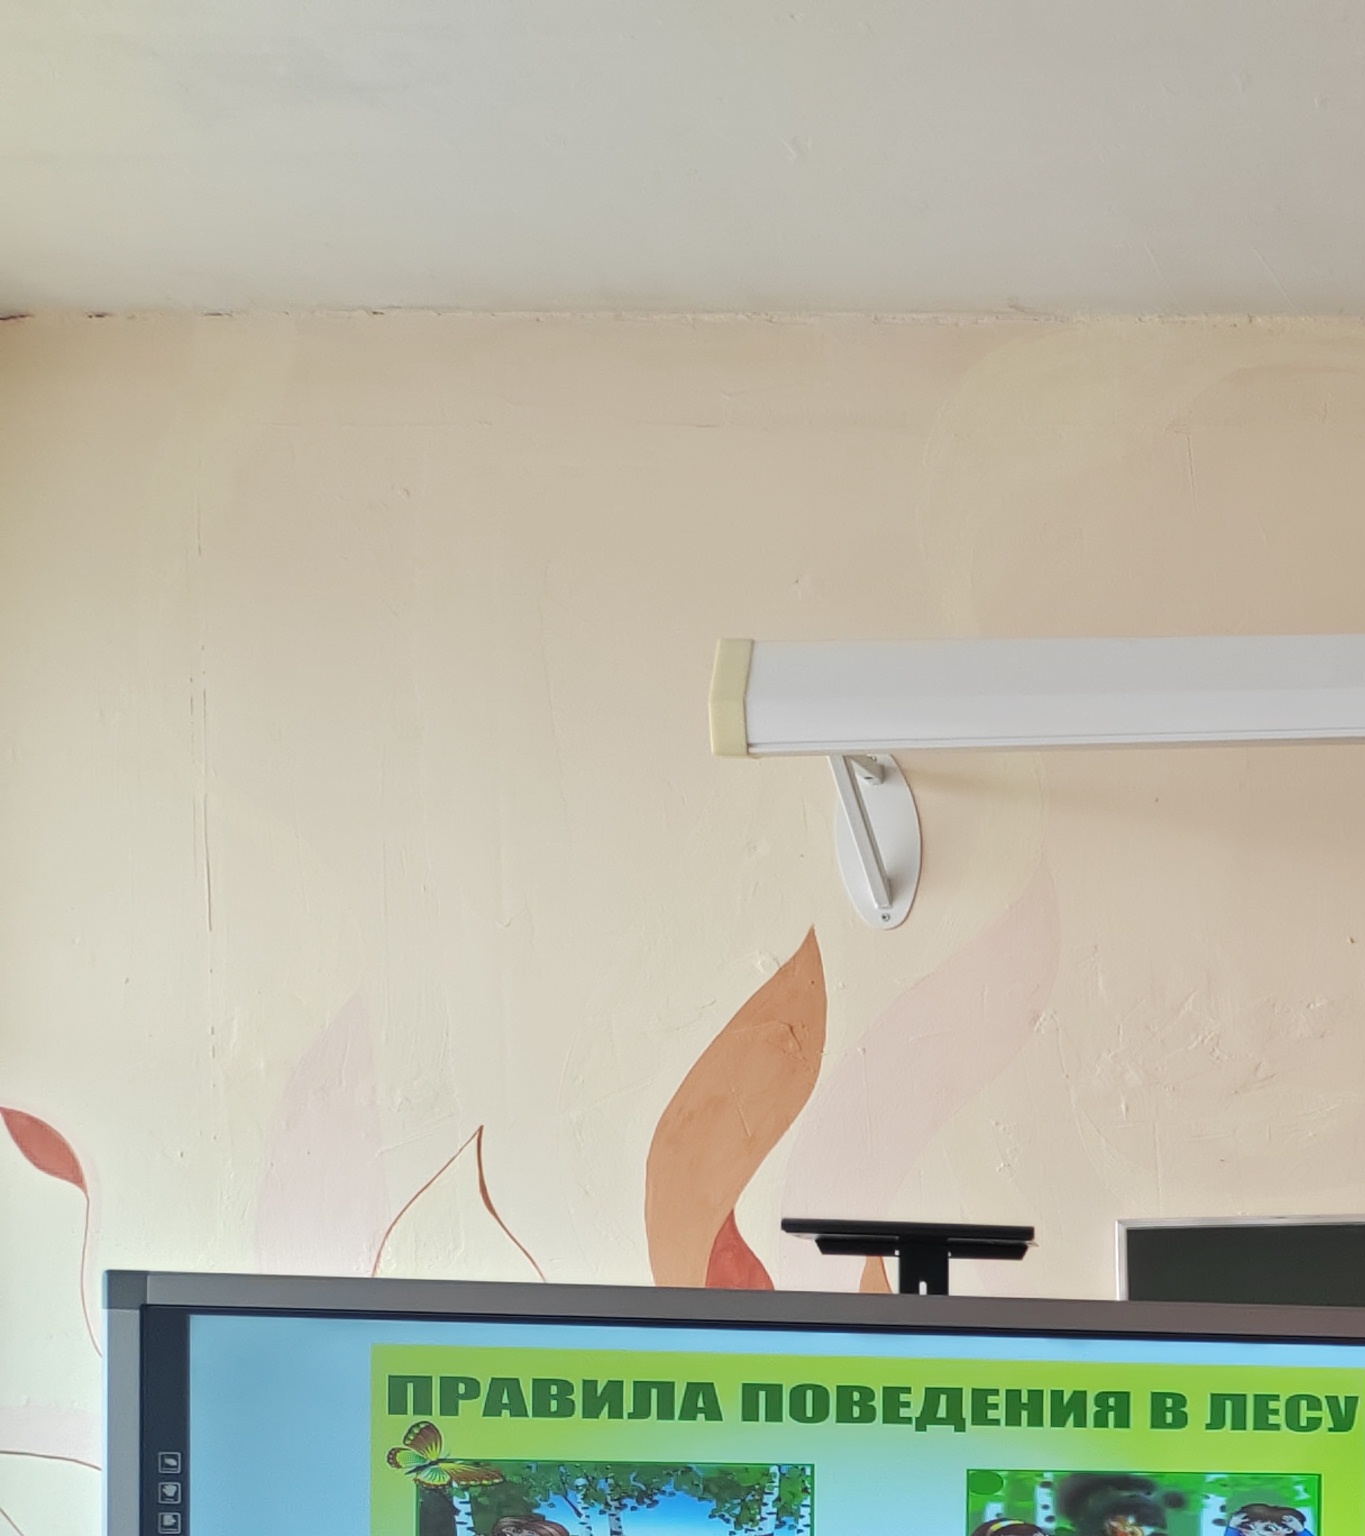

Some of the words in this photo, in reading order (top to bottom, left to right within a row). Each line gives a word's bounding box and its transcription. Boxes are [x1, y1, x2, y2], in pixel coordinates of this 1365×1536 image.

[388, 1374, 723, 1421] ПРАВИЛА
[741, 1382, 1131, 1432] ПОВЕДЕНИЯ
[1149, 1391, 1188, 1430] В
[1205, 1392, 1359, 1433] ЛЕСУ
